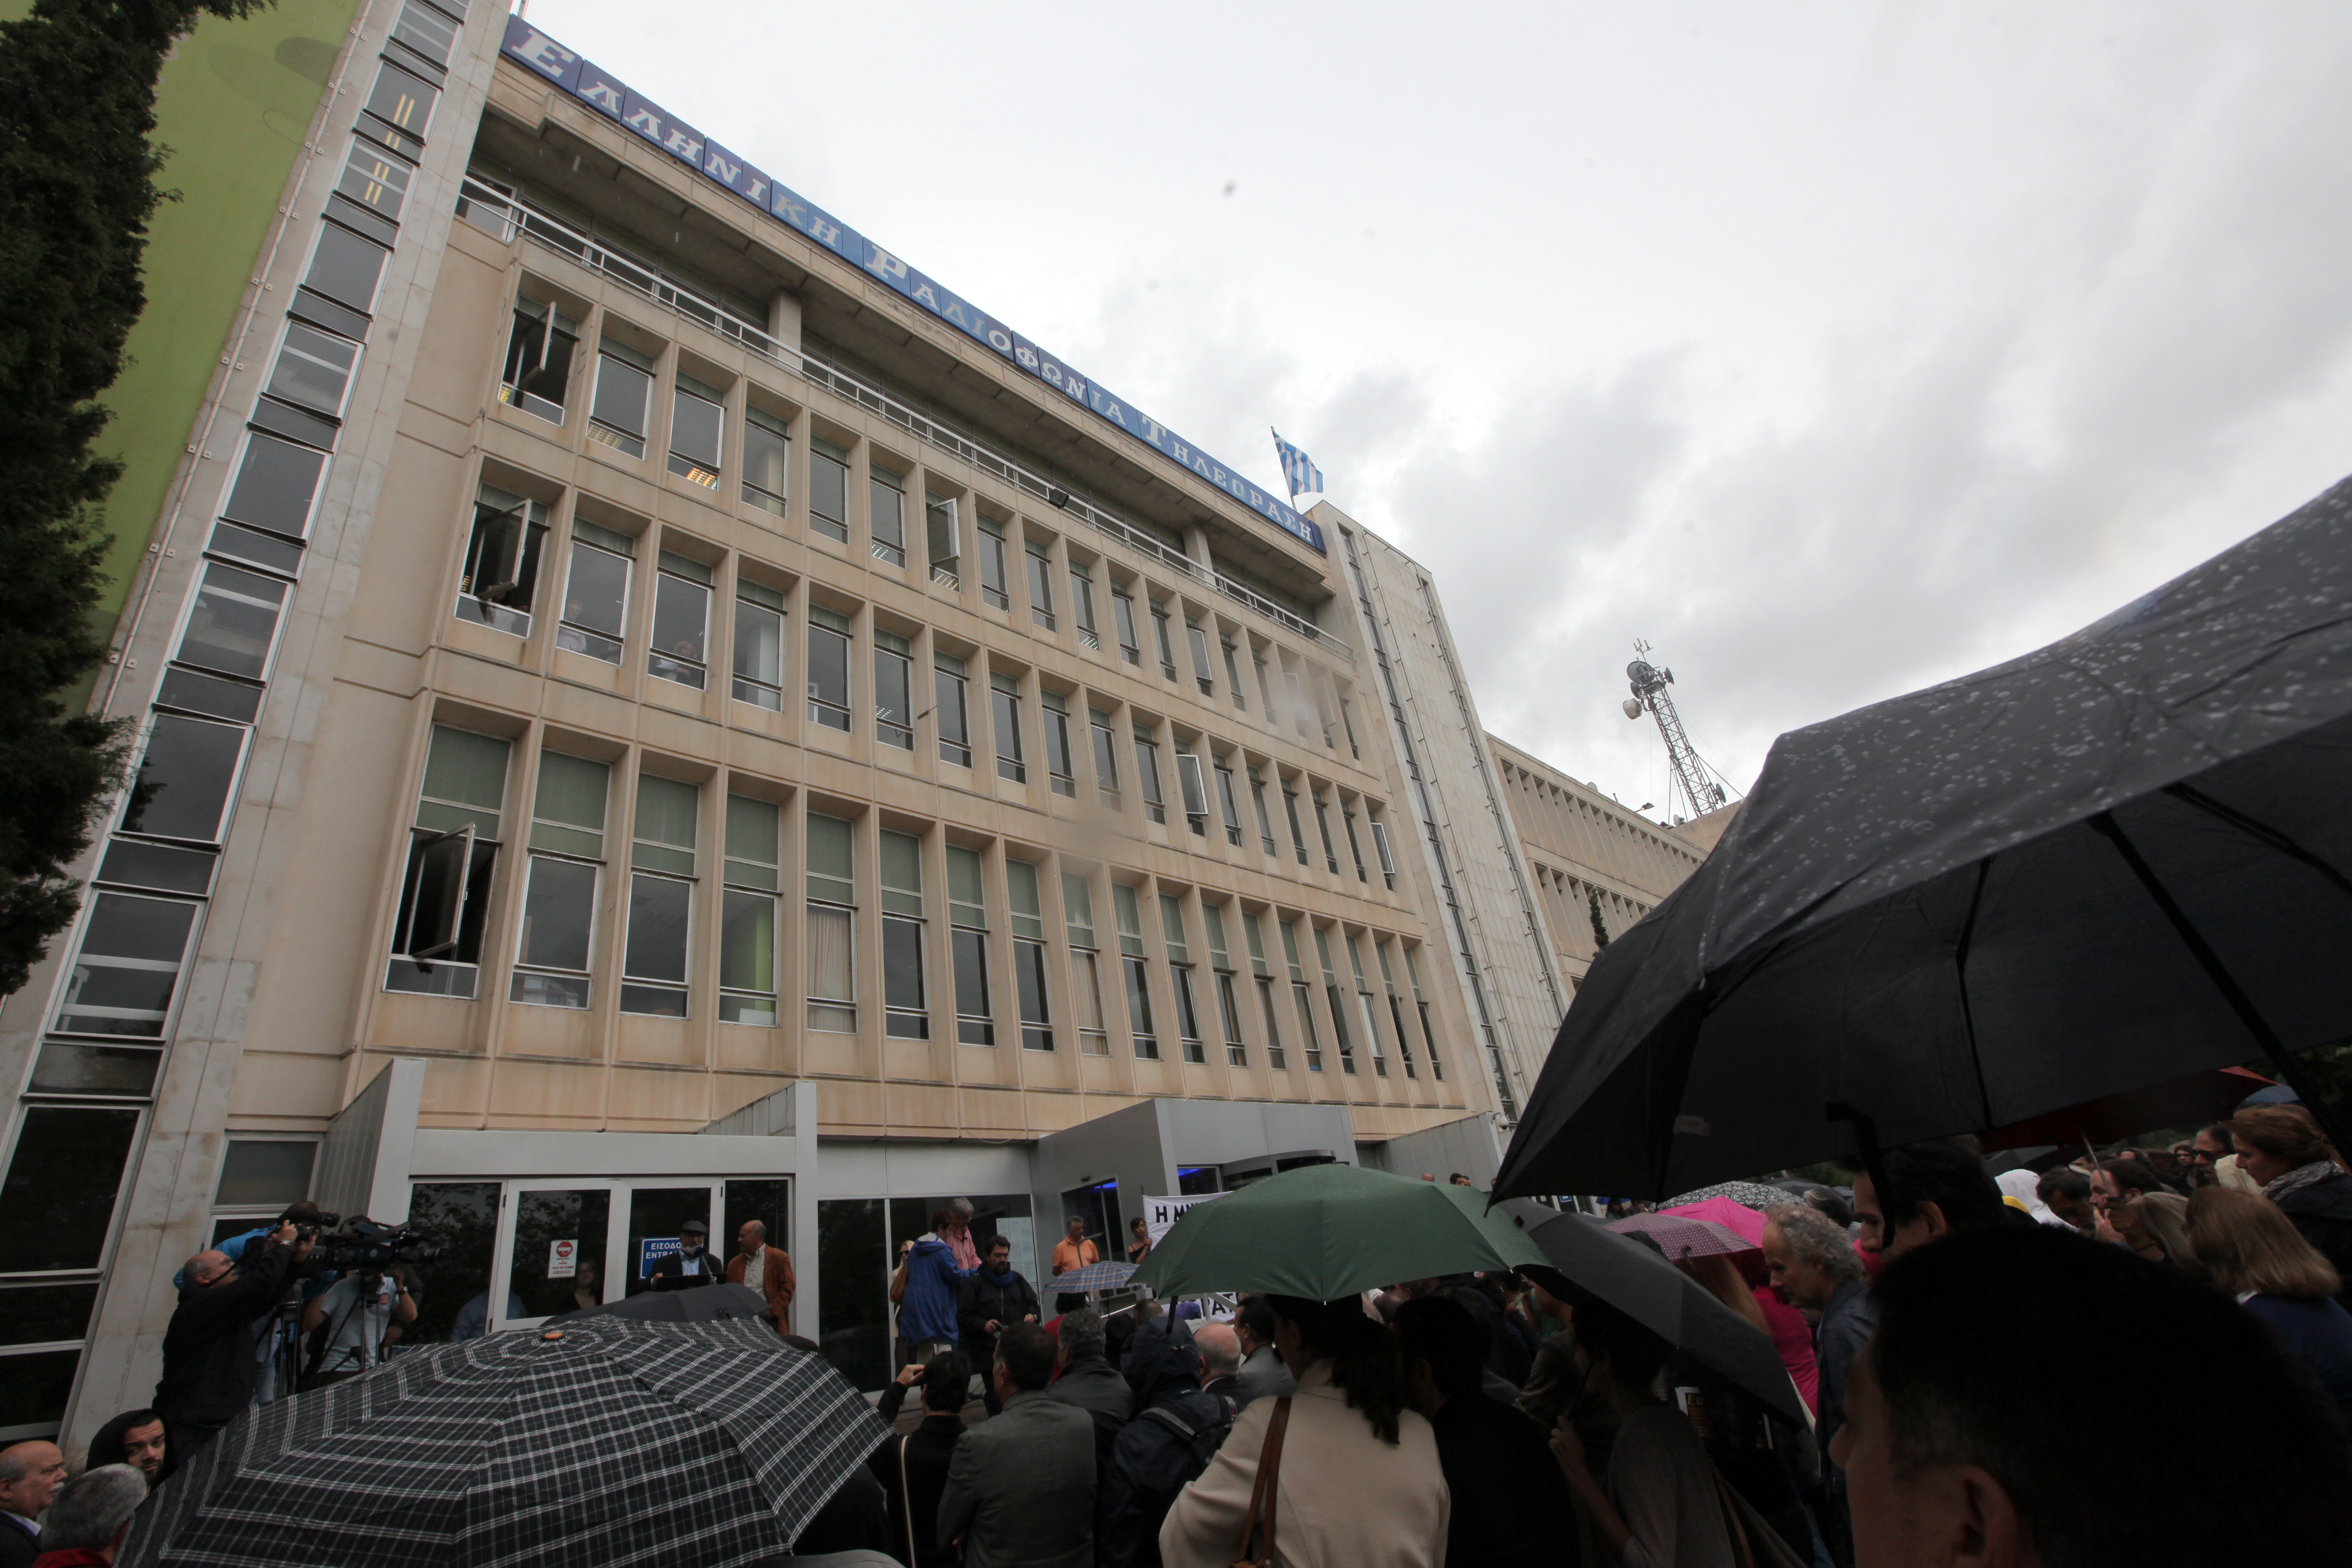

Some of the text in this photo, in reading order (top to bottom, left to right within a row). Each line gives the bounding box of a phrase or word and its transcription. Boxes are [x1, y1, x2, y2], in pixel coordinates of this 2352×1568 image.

[511, 28, 1312, 542] ΕΛΛΗΝΙΚΗ ΡΑΔΙΟΦΩΝΙΑ ΤΗΛΕΟΡΑΣΗ
[646, 1251, 677, 1259] ENTR
